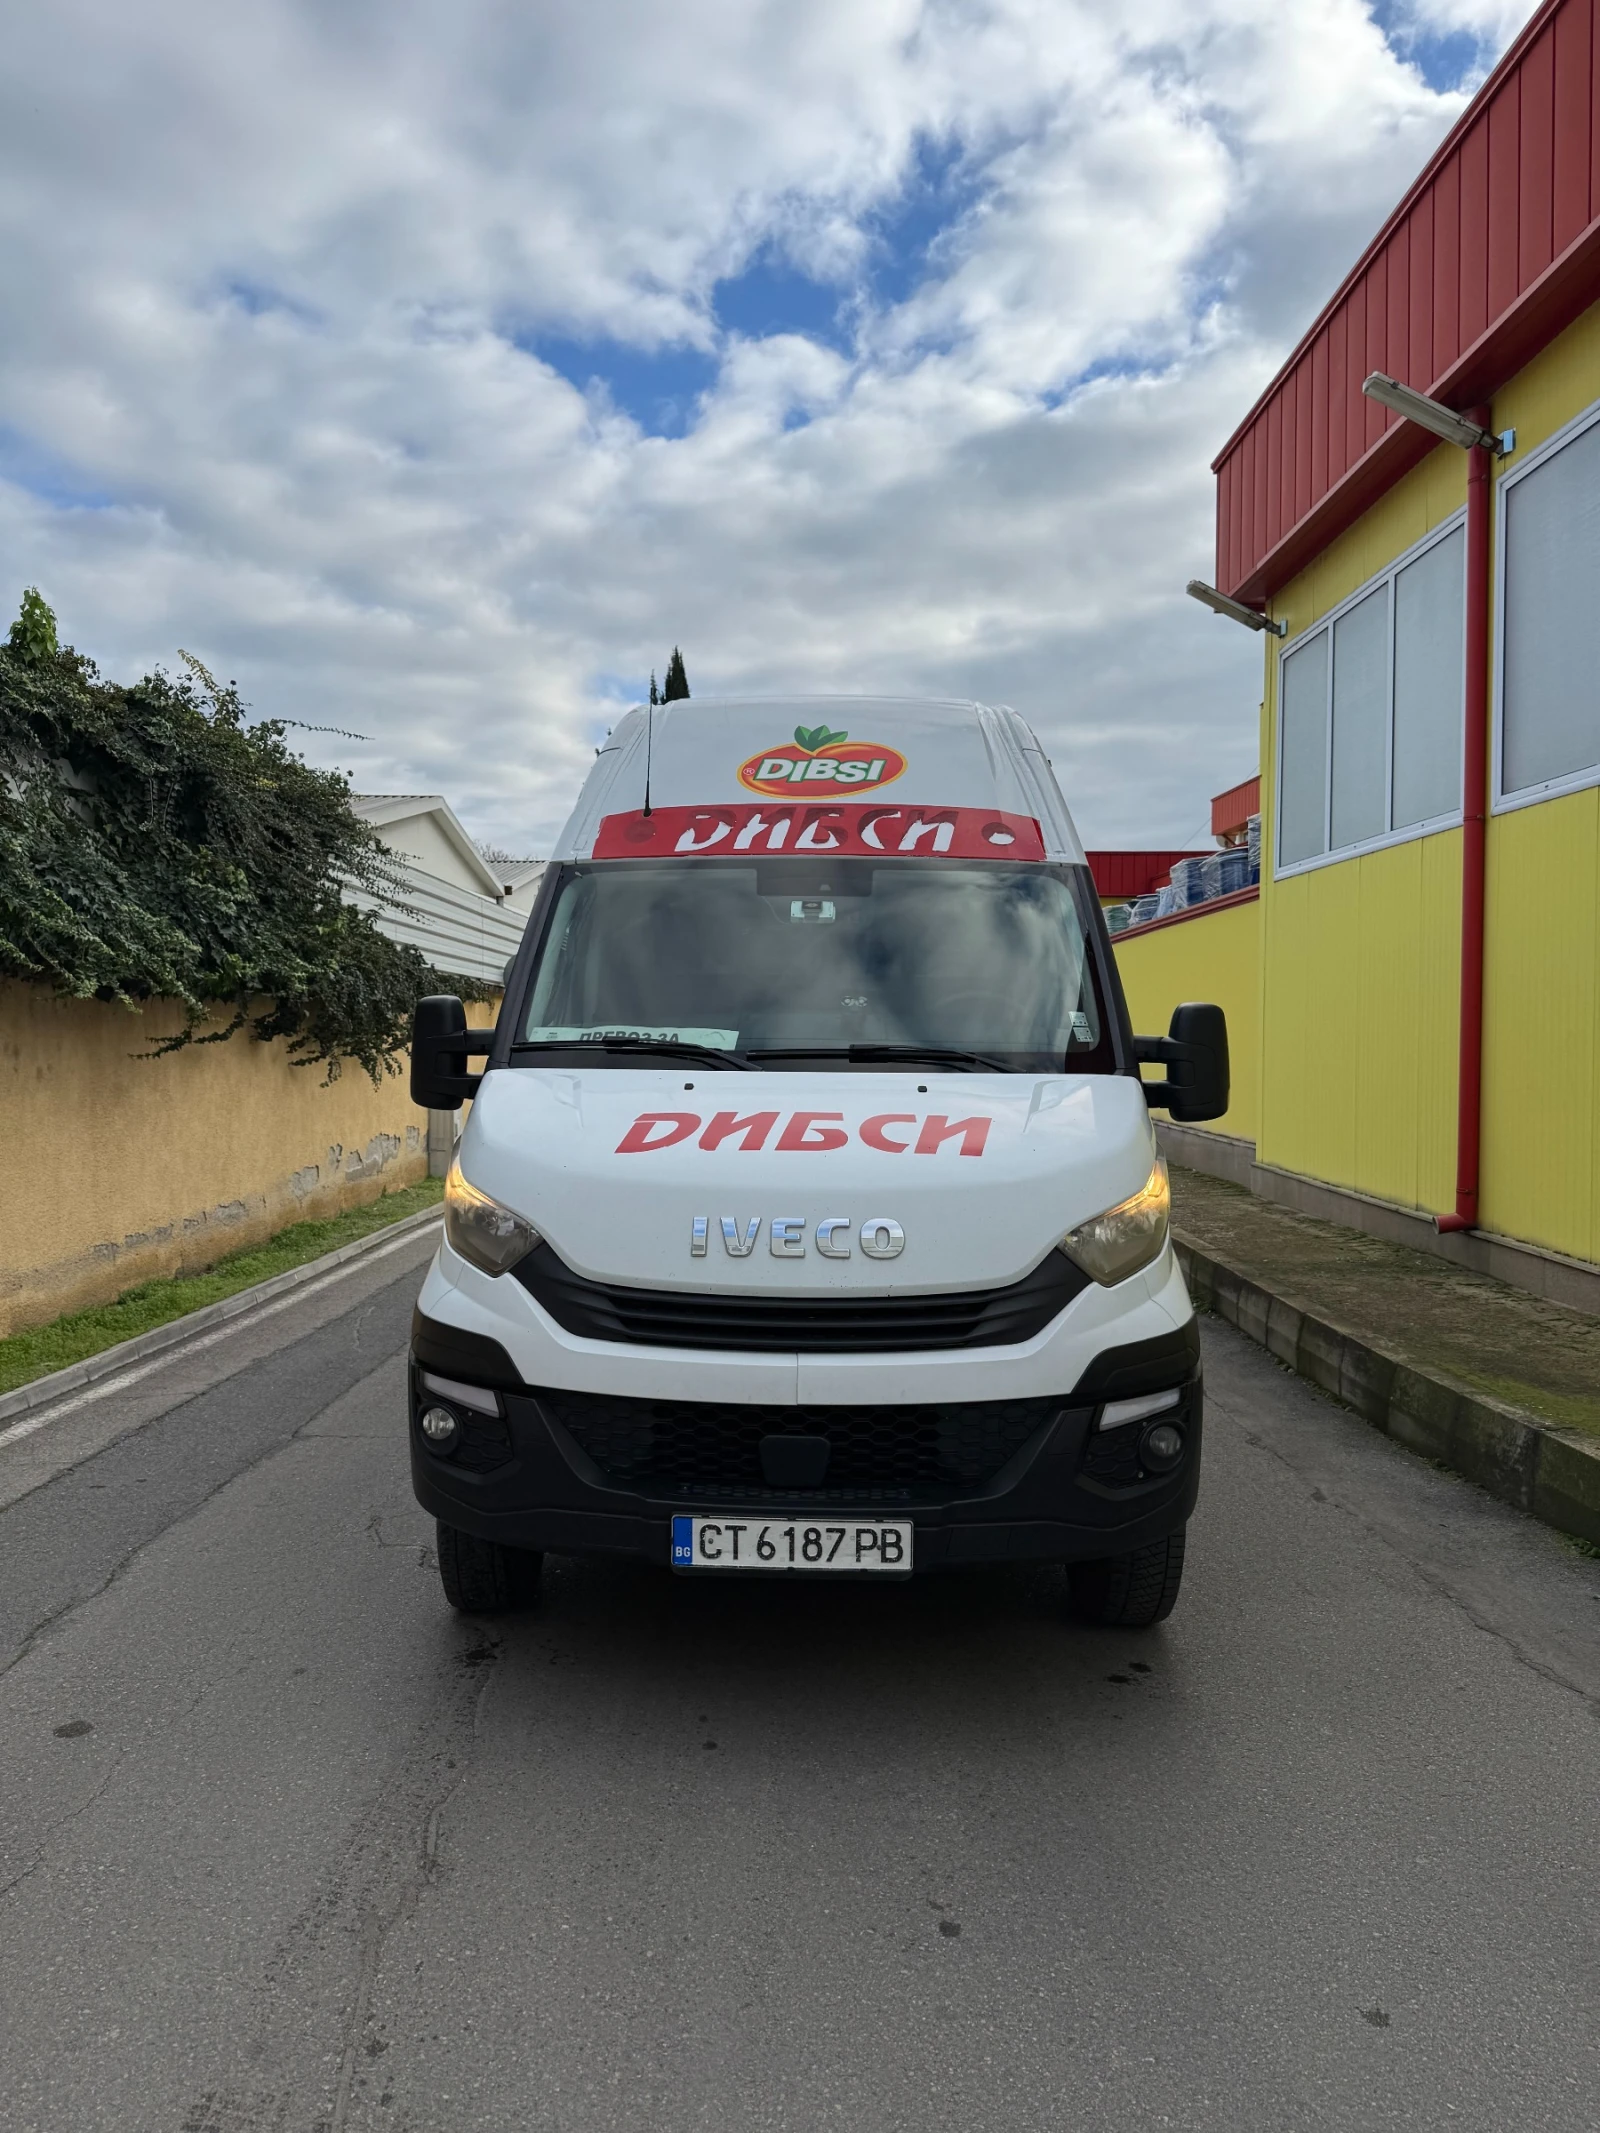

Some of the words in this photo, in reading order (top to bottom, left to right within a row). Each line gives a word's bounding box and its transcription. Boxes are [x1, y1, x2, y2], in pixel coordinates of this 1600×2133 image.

[753, 757, 887, 784] DIBSI
[690, 1216, 906, 1260] IVECO
[675, 1546, 691, 1557] BG
